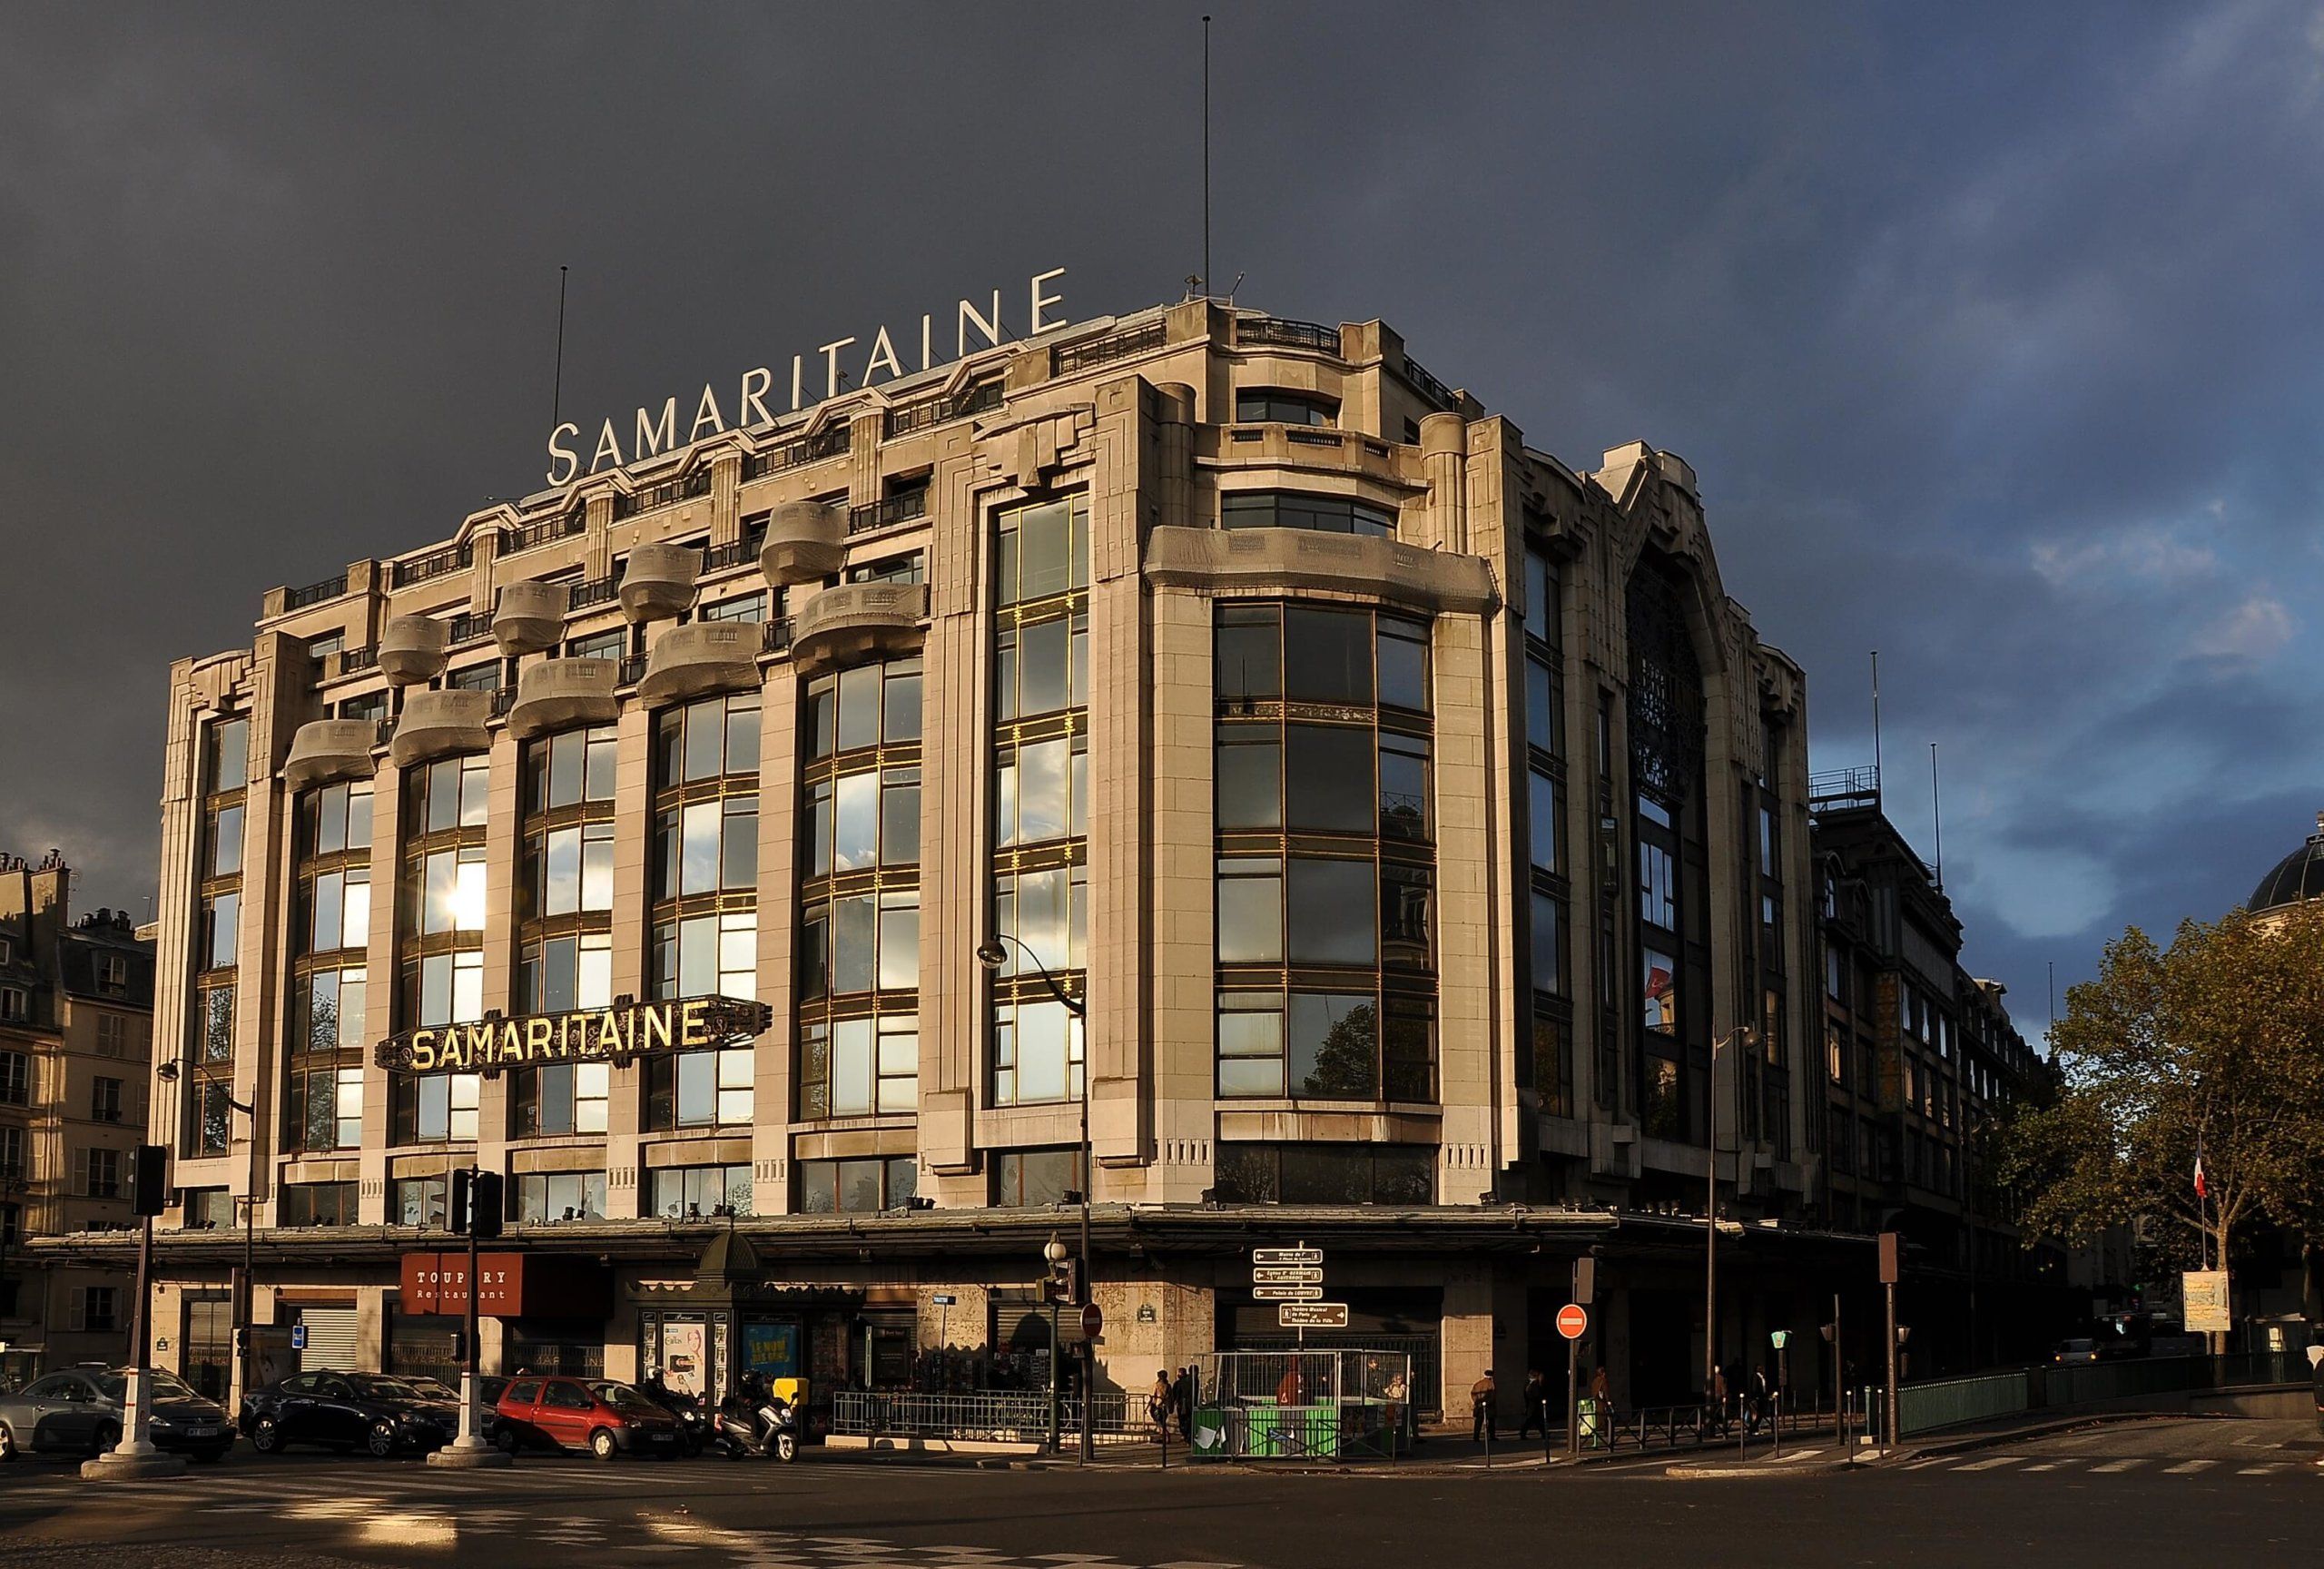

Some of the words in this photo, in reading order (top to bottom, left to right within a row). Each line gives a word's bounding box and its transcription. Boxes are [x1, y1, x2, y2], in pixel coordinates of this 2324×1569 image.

[547, 266, 1067, 487] SAMARITAINE
[411, 1000, 710, 1071] SAMARITAINE
[417, 1271, 506, 1283] TOUPRY
[417, 1289, 506, 1298] Restauant
